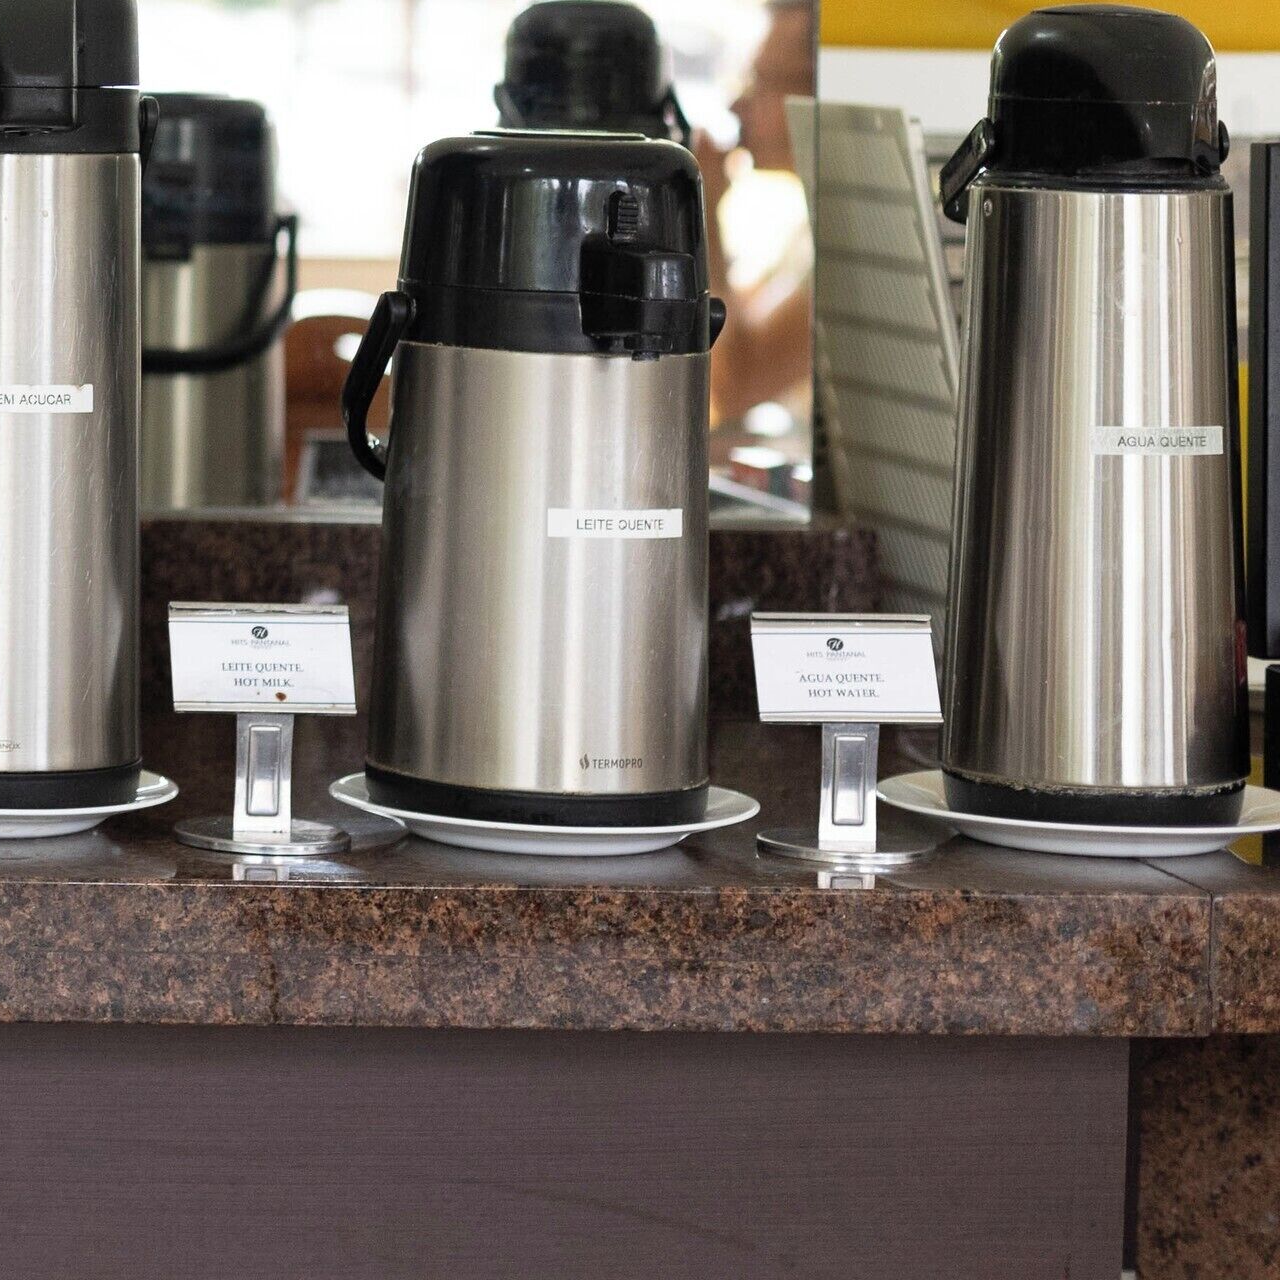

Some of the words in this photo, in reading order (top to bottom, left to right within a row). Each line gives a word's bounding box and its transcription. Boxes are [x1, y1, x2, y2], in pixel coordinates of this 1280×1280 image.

[1117, 436, 1155, 447] AGUA
[1160, 436, 1207, 448] QUENTE
[576, 519, 614, 530] LEITE
[222, 663, 252, 671] LEITE
[234, 678, 260, 686] HOT
[808, 689, 832, 697] HOT
[592, 759, 643, 769] TERMOPRO
